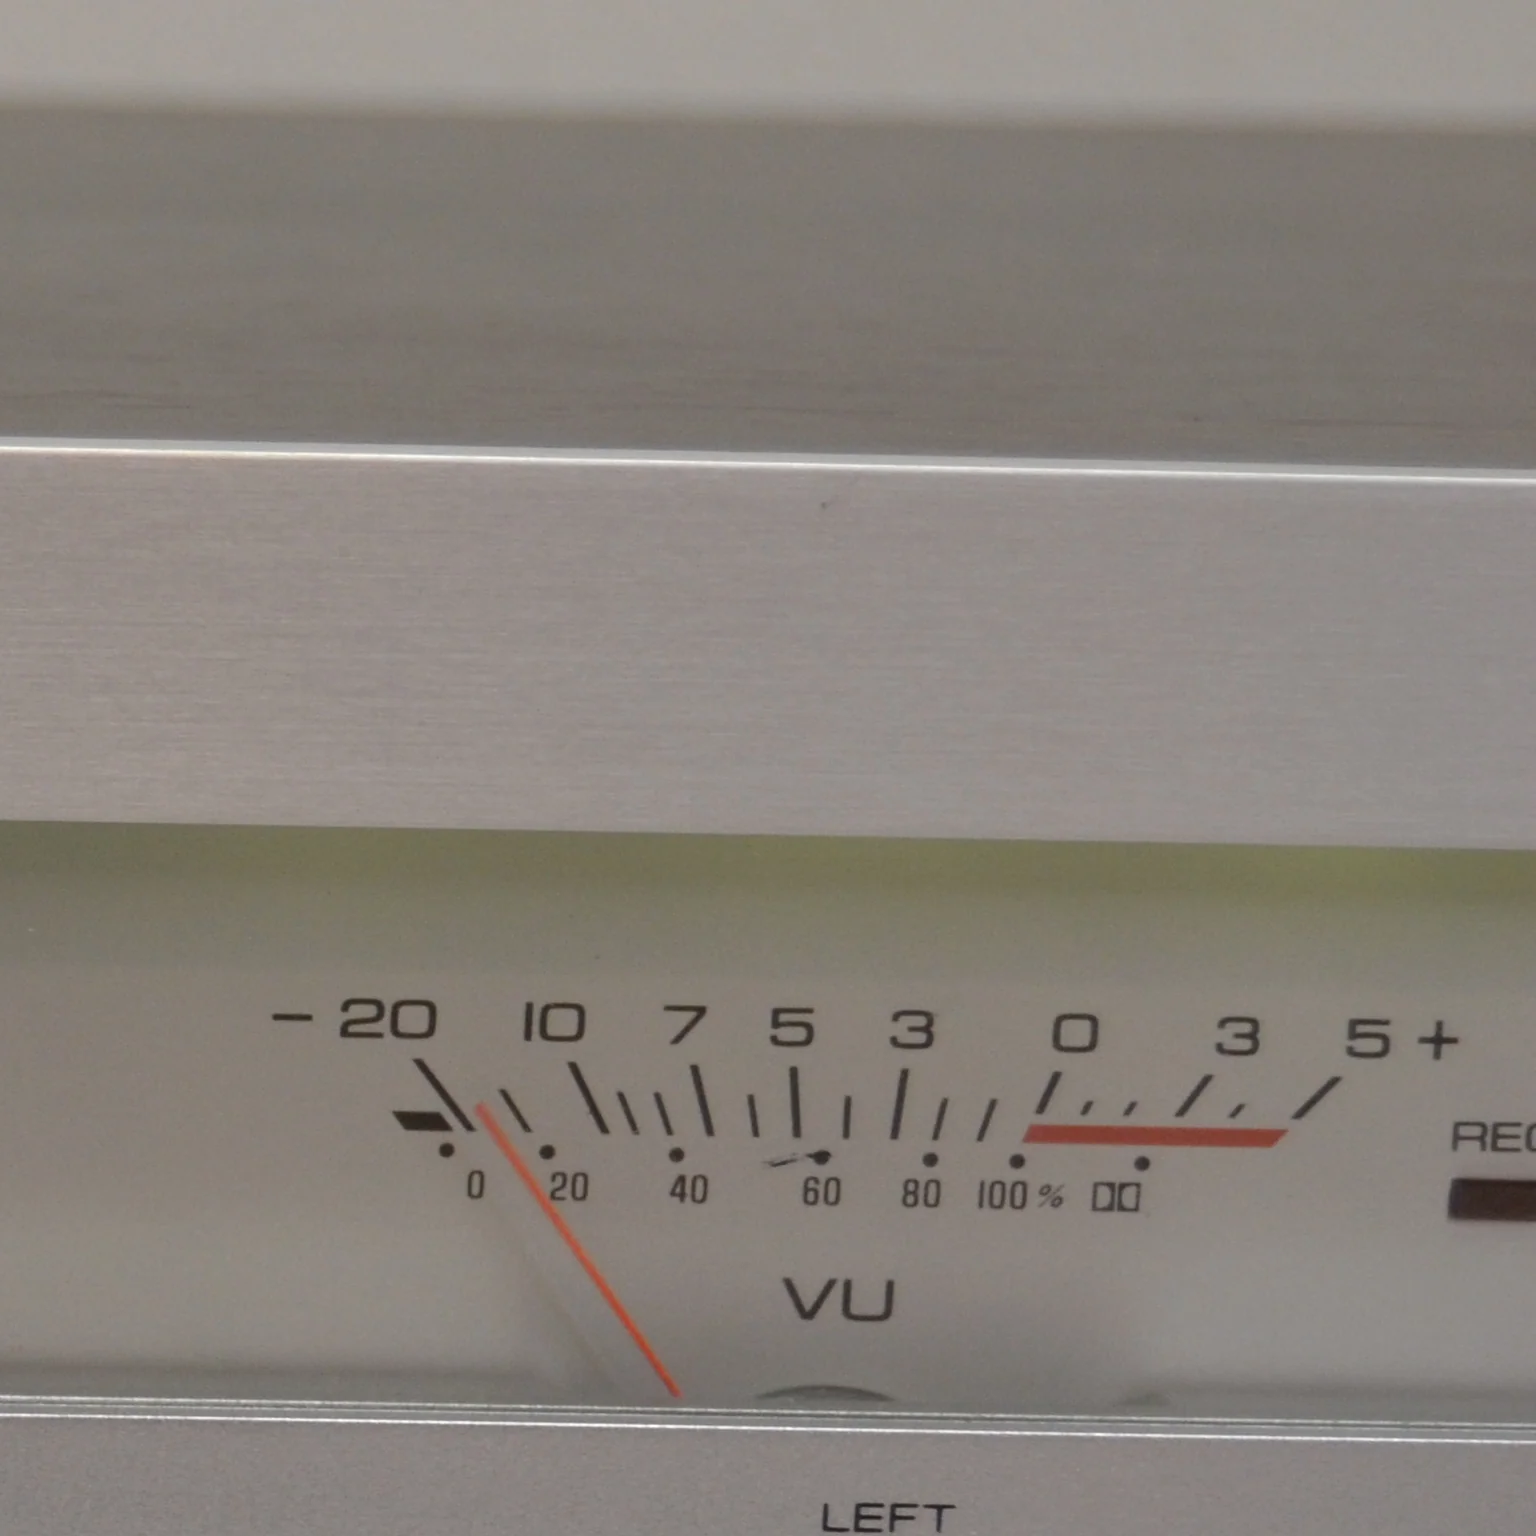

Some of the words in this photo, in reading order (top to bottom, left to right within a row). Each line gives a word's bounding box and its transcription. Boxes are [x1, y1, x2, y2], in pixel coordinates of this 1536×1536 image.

[339, 997, 438, 1040] 20
[523, 1001, 586, 1043] 10
[663, 1004, 708, 1045] 7
[769, 1007, 815, 1048] 5
[889, 1009, 935, 1050] 3
[1051, 1012, 1100, 1054] 0
[1215, 1016, 1261, 1057] 3
[1346, 1018, 1391, 1059] 5
[466, 1169, 486, 1200] 0
[549, 1171, 589, 1202] 20
[669, 1174, 709, 1205] 40
[802, 1175, 842, 1207] 60
[901, 1178, 942, 1209] 80
[977, 1179, 1029, 1211] 100
[782, 1277, 895, 1323] VU
[821, 1502, 956, 1534] LEFT
